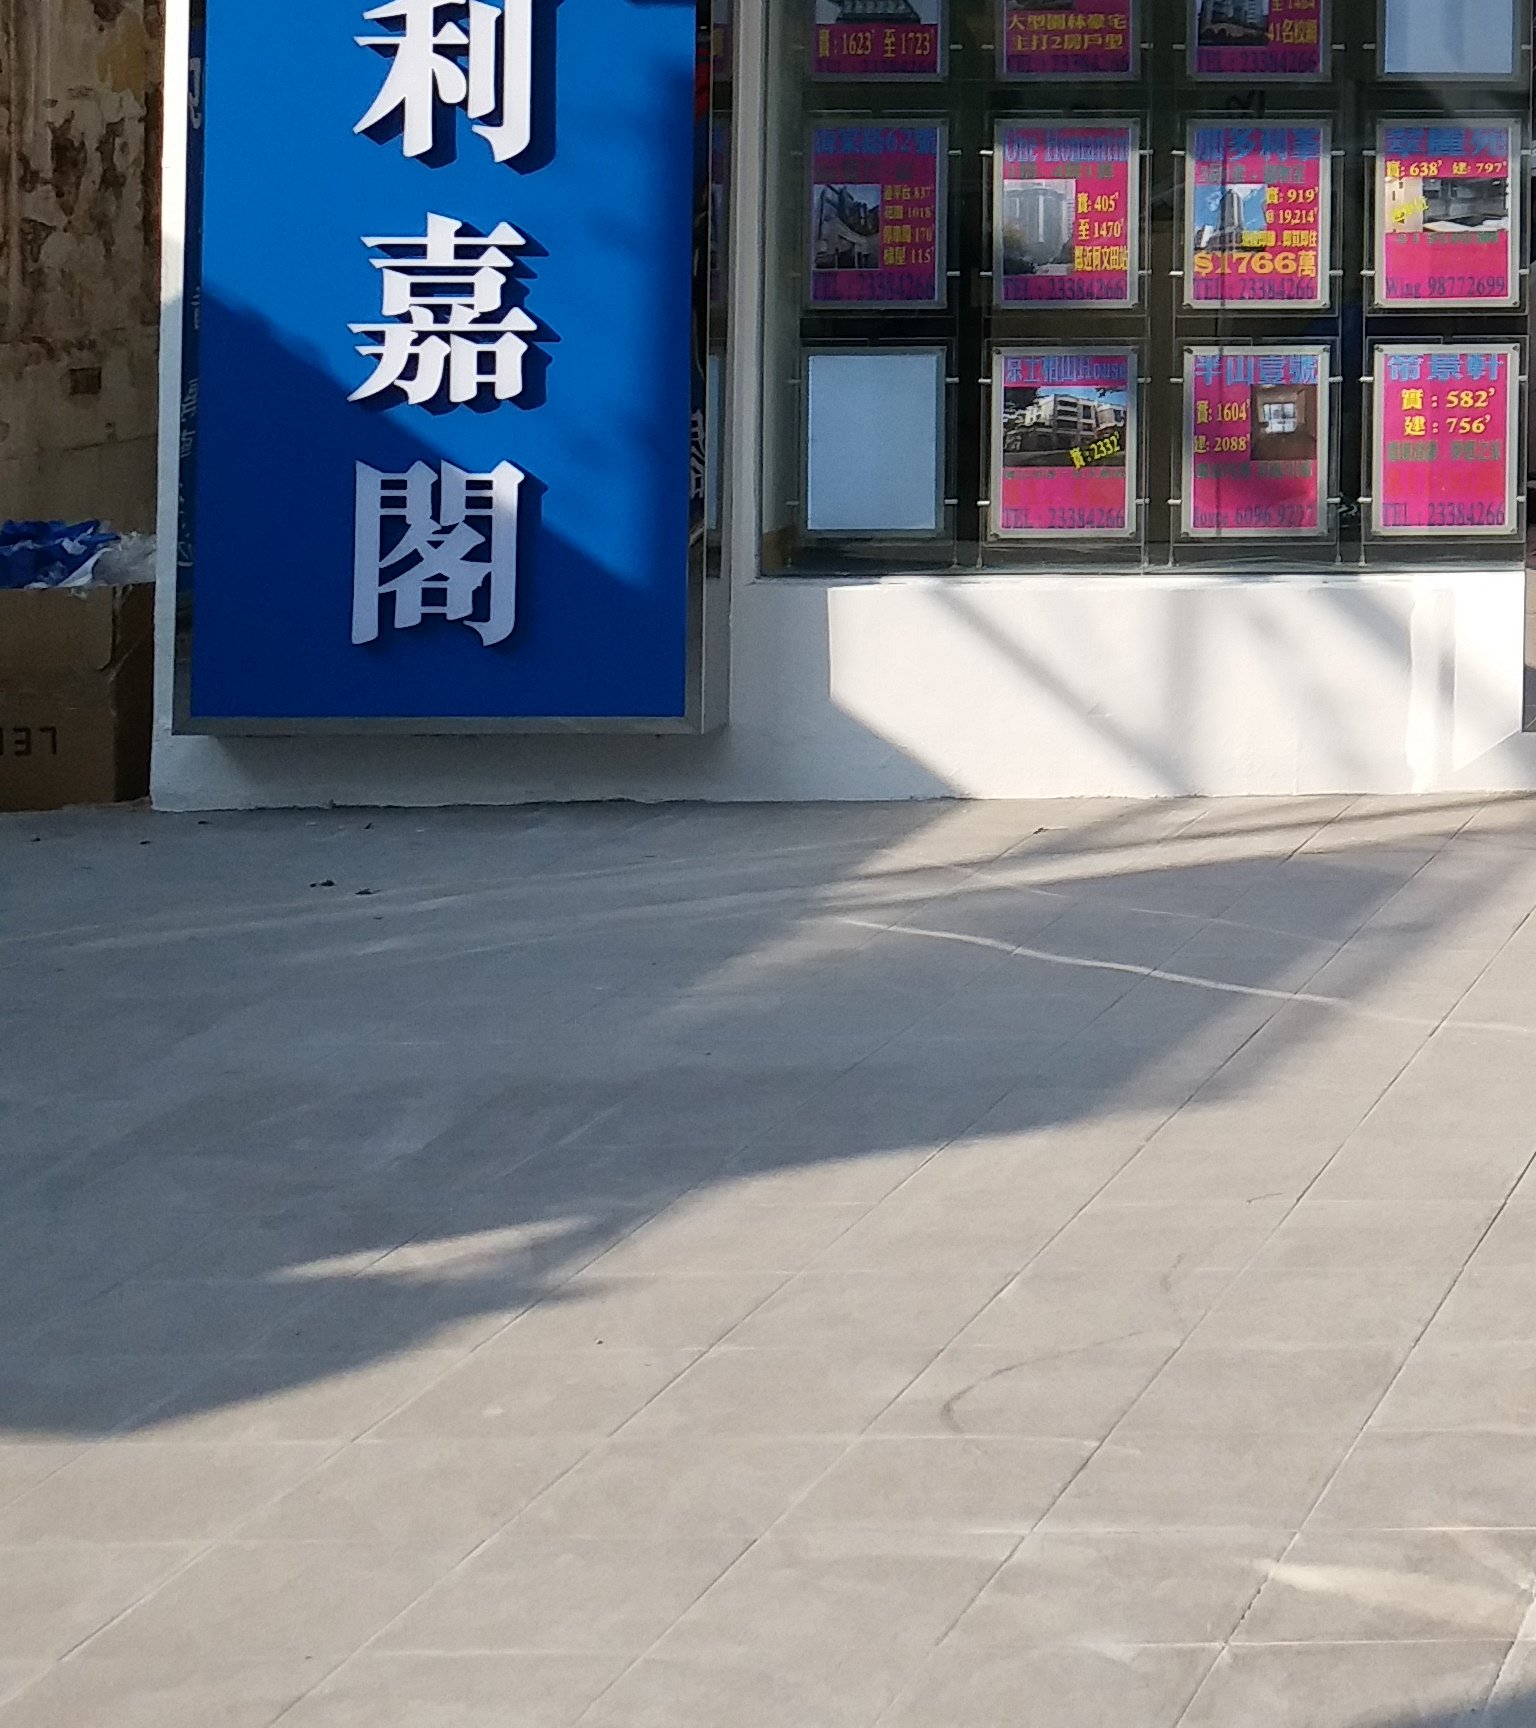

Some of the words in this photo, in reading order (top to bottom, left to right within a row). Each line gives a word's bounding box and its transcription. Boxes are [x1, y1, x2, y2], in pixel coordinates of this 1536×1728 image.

[1410, 159, 1442, 176] 638'
[1194, 250, 1316, 277] $1766萬
[1446, 387, 1496, 408] 582'
[1446, 414, 1492, 434] 756'
